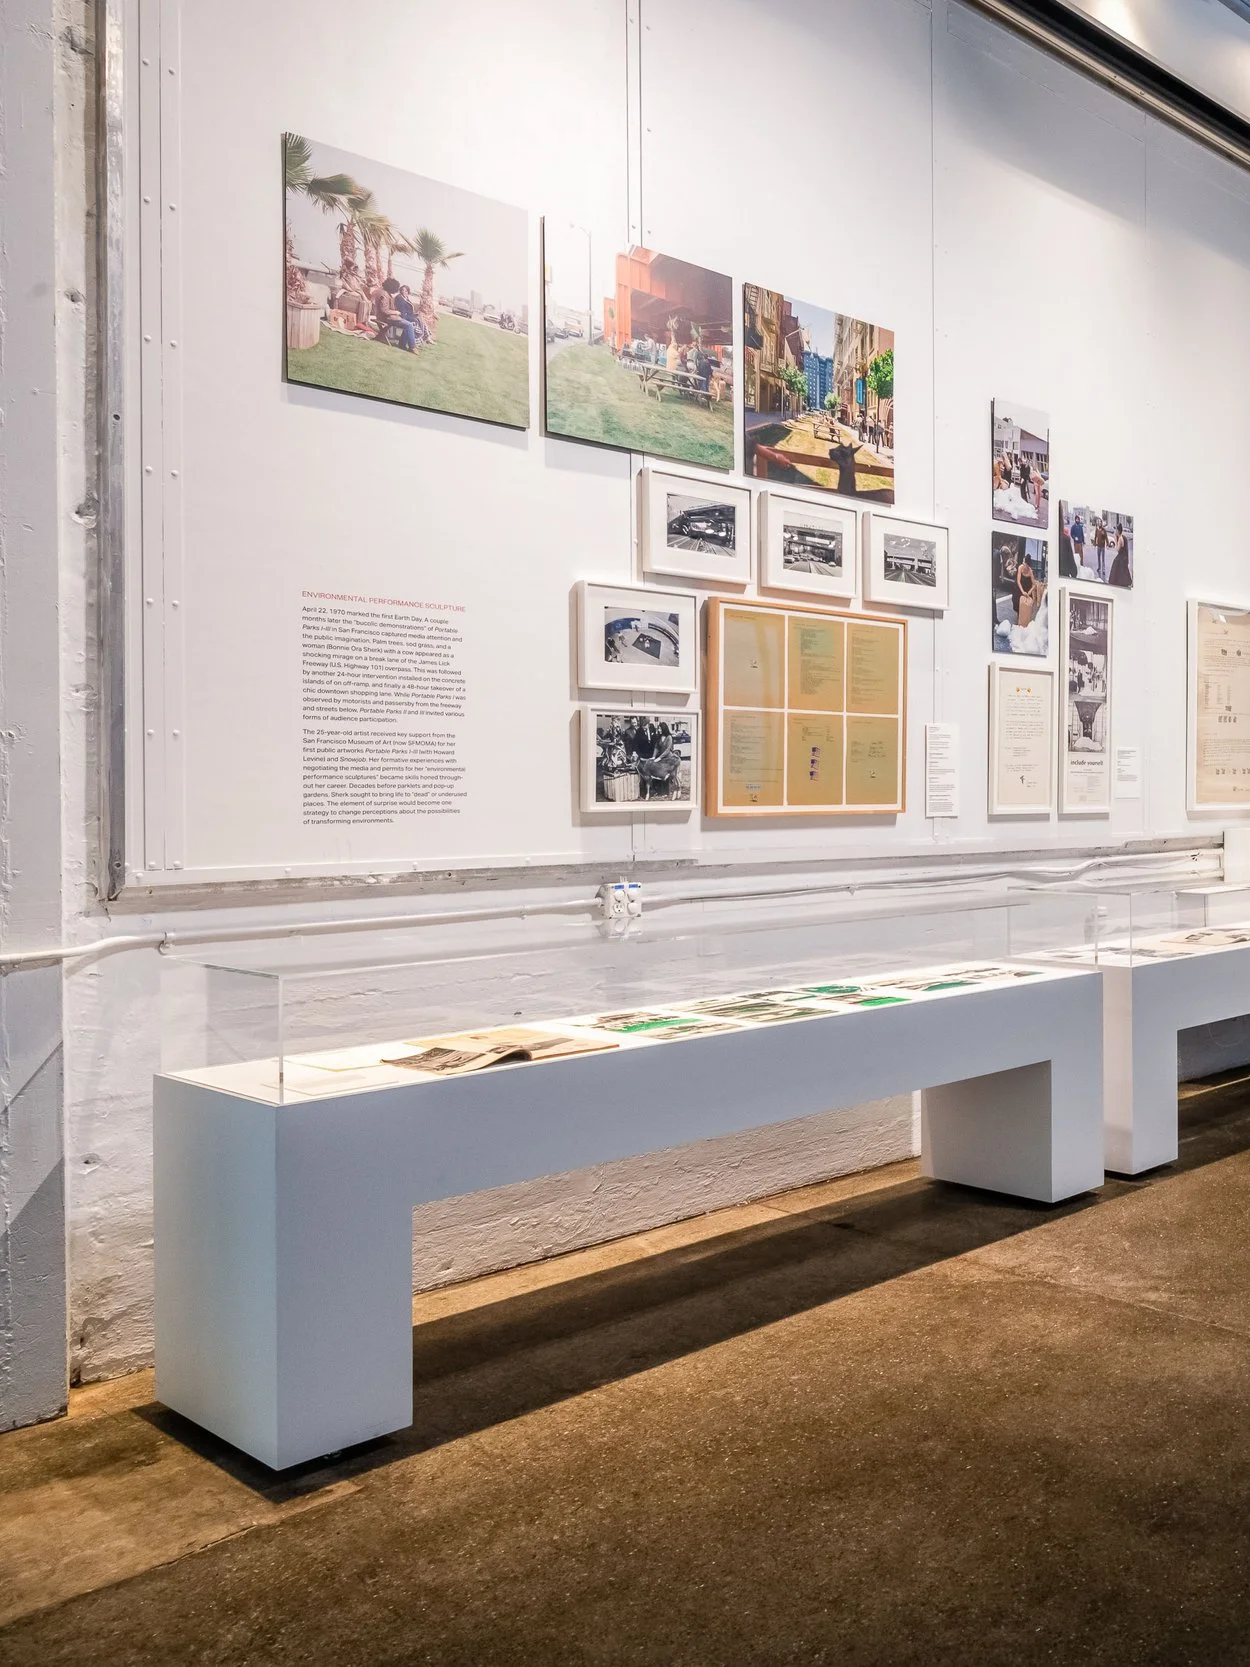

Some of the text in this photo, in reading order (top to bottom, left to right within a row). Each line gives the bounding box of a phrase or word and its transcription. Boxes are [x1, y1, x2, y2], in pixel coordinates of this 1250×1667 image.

[302, 591, 466, 612] ENVIRONMENTAL PERFORMANCE SCULPTURE
[351, 627, 380, 636] Francisco
[302, 651, 331, 660] shocking
[332, 653, 353, 661] mirage
[302, 659, 328, 669] Freeway
[317, 687, 349, 695] downtown
[350, 689, 378, 698] shopping
[302, 773, 344, 781] performance
[350, 791, 371, 799] sought
[303, 809, 329, 817] strategy
[362, 808, 398, 816] perceptions
